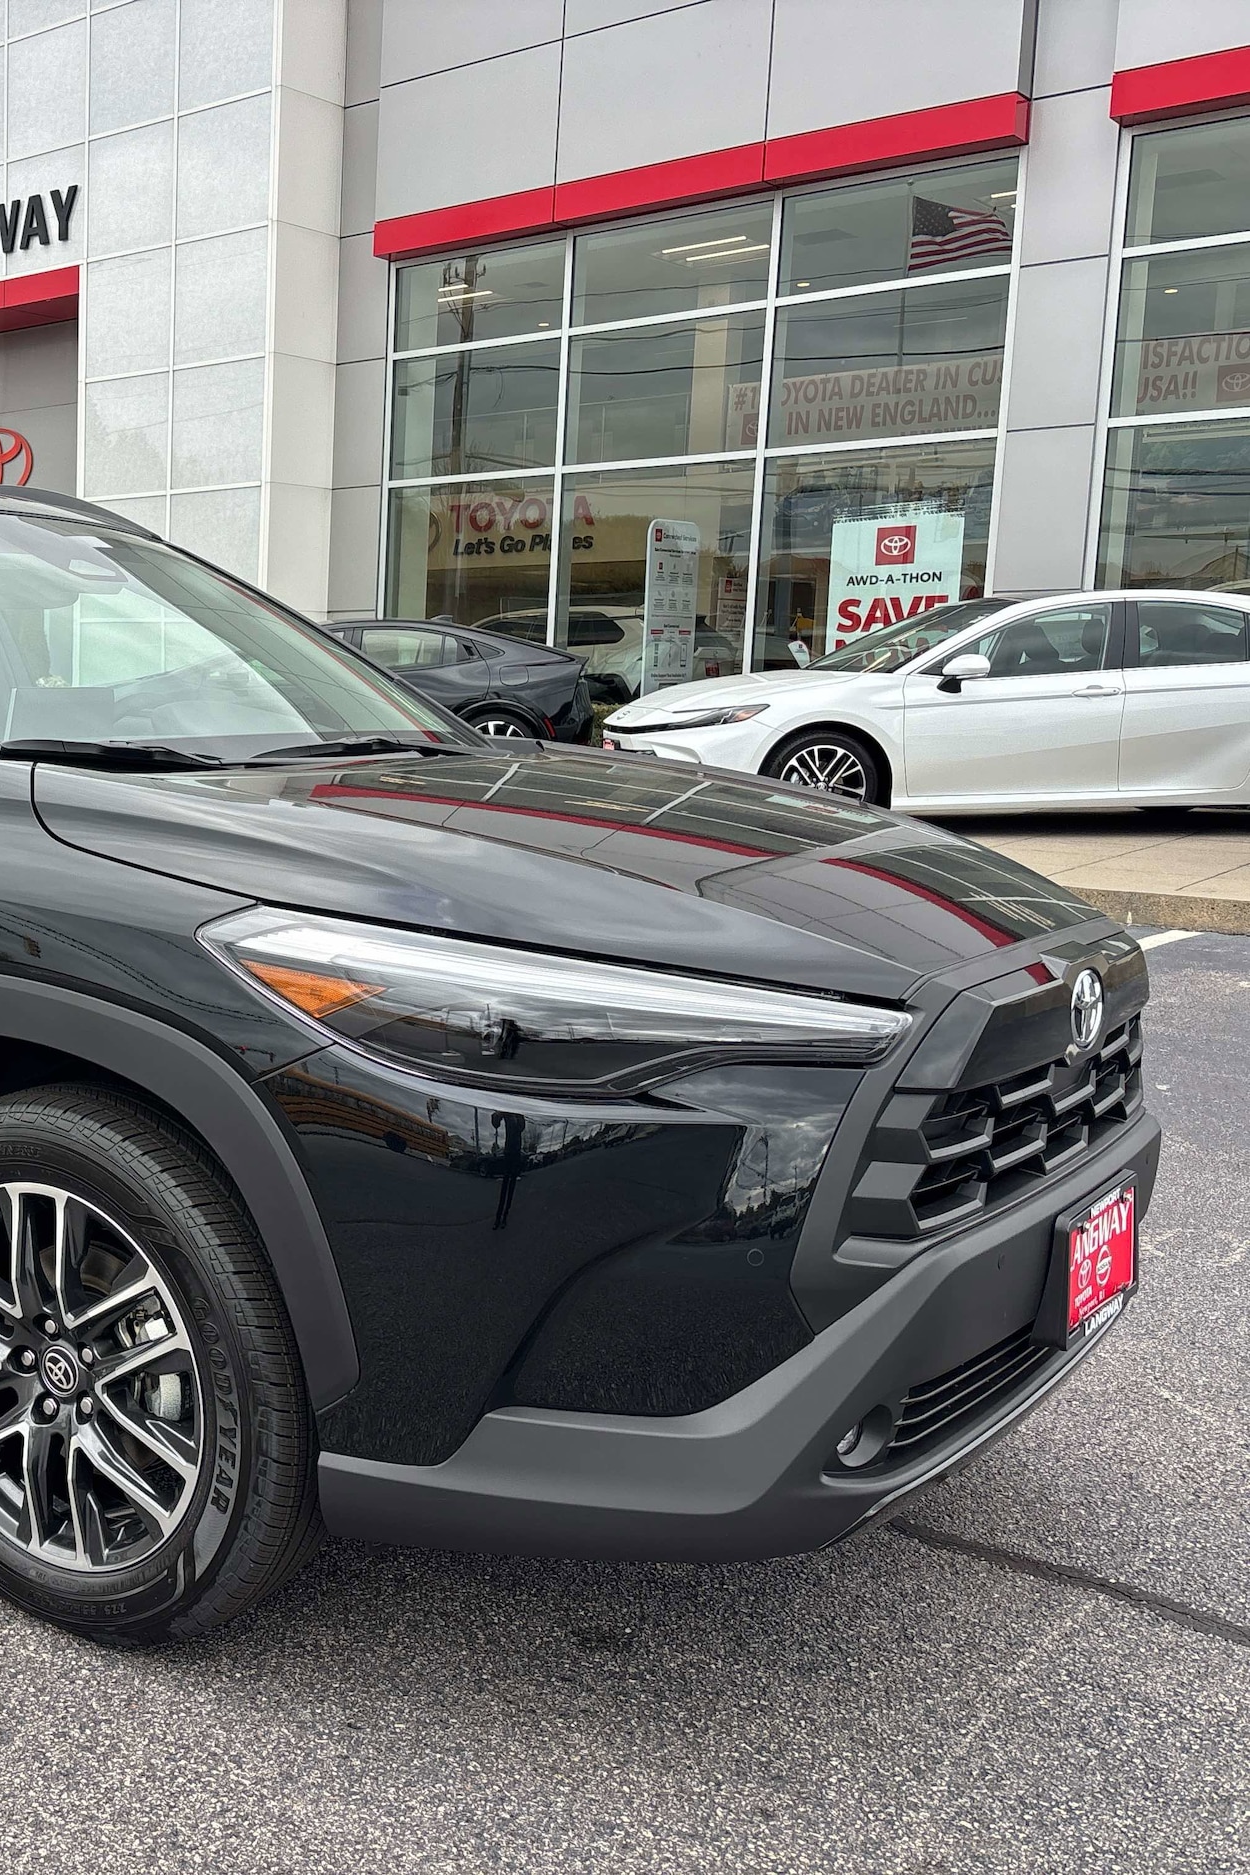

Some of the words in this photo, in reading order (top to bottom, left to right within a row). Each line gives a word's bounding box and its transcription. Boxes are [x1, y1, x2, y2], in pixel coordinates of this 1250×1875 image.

[781, 377, 843, 407] OYOTA
[851, 368, 927, 399] DEALER
[934, 365, 959, 391] IN
[967, 359, 1002, 388] CU
[786, 411, 810, 435] IN
[817, 405, 864, 432] NEW
[448, 495, 595, 534] TOYOA
[453, 536, 496, 556] Let's
[500, 535, 526, 554] Go
[529, 533, 594, 552] Ples
[846, 571, 942, 587] AWD-A-THON
[1090, 1187, 1122, 1219] NEWPORT
[1084, 1293, 1124, 1337] LANGWAY
[192, 1296, 238, 1516] GOODYEAR
